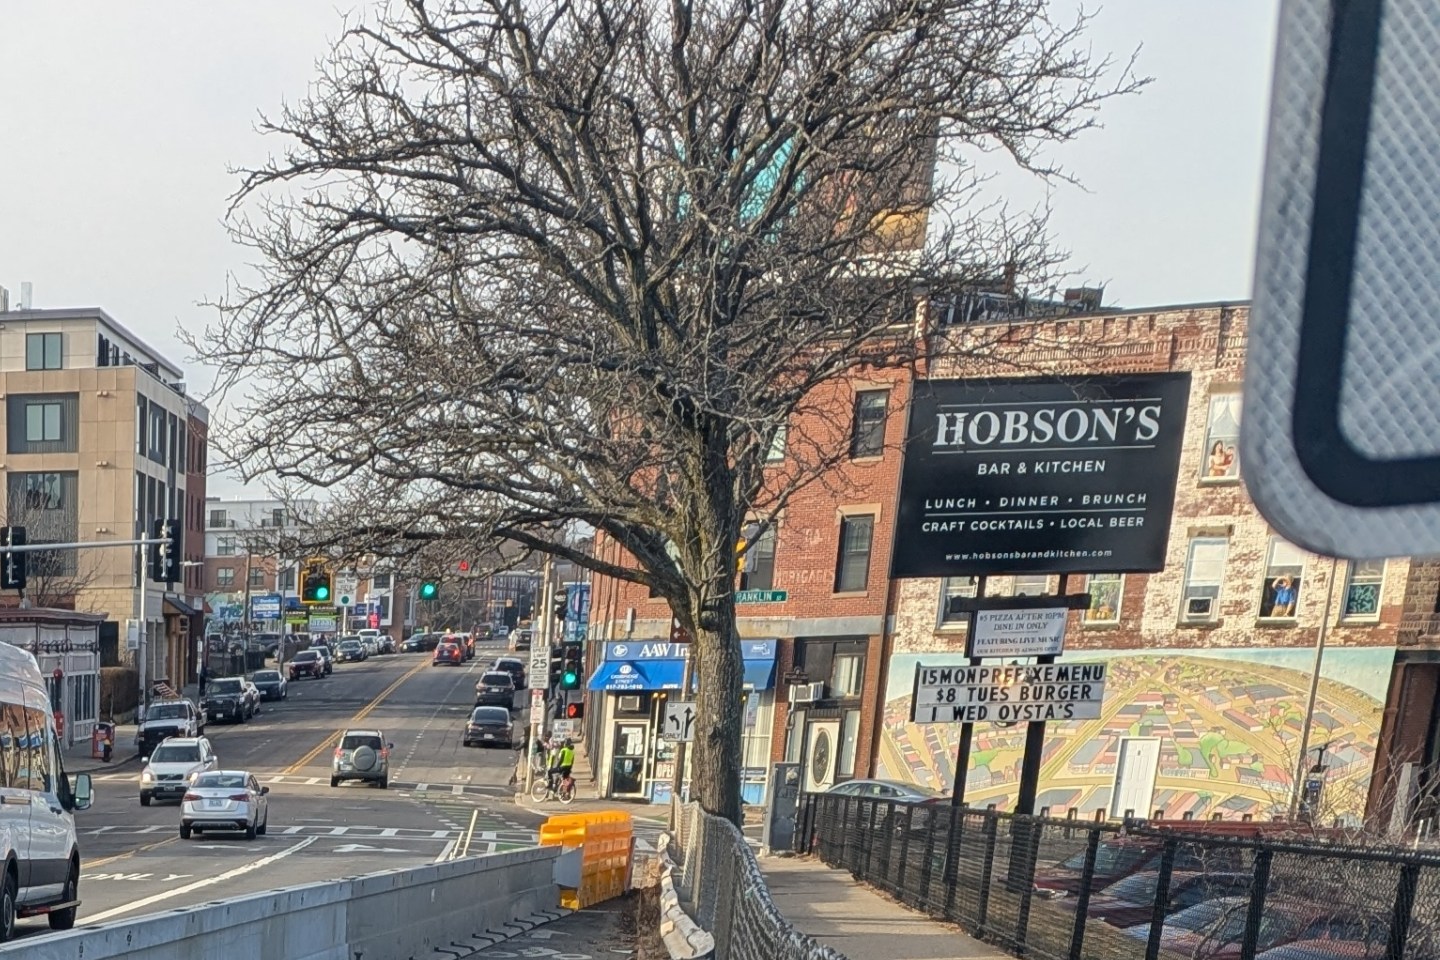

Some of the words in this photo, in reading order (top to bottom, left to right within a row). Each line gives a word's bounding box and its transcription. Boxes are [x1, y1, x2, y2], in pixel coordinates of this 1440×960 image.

[932, 406, 1161, 445] HOBSON'S
[977, 462, 1010, 475] BAR
[1017, 462, 1027, 474] &
[1034, 460, 1106, 473] KITCHEN
[925, 498, 976, 509] LUNCH
[999, 496, 1059, 507] DINNER
[1082, 493, 1147, 505] BRUNCH
[922, 521, 965, 532] CRAFT
[970, 519, 1044, 531] COCKTAILS
[1060, 517, 1104, 529] LOCAL
[1109, 516, 1144, 528] BEER
[945, 550, 1112, 560] www.hobsonsbarandkitchen.com
[735, 592, 773, 602] RANKLIN
[989, 613, 1013, 621] PIZZA
[1015, 612, 1043, 621] AFTER
[1045, 611, 1065, 620] 10PM
[993, 623, 1014, 631] DINE
[1015, 622, 1025, 630] IN
[1026, 621, 1048, 630] ONLY
[977, 637, 1018, 645] FEATURING
[1019, 636, 1035, 644] LIVE
[1038, 635, 1060, 643] MUSIC
[639, 643, 671, 657] AAW
[674, 643, 690, 657] In
[531, 658, 548, 669] 25
[936, 687, 956, 703] $8
[967, 686, 1010, 702] TUES
[1020, 684, 1092, 701] BURGER
[953, 705, 987, 721] WED
[998, 703, 1074, 720] OYSTA'S
[665, 732, 680, 740] ONLY
[656, 762, 675, 779] OPE
[80, 873, 194, 882] ONLY
